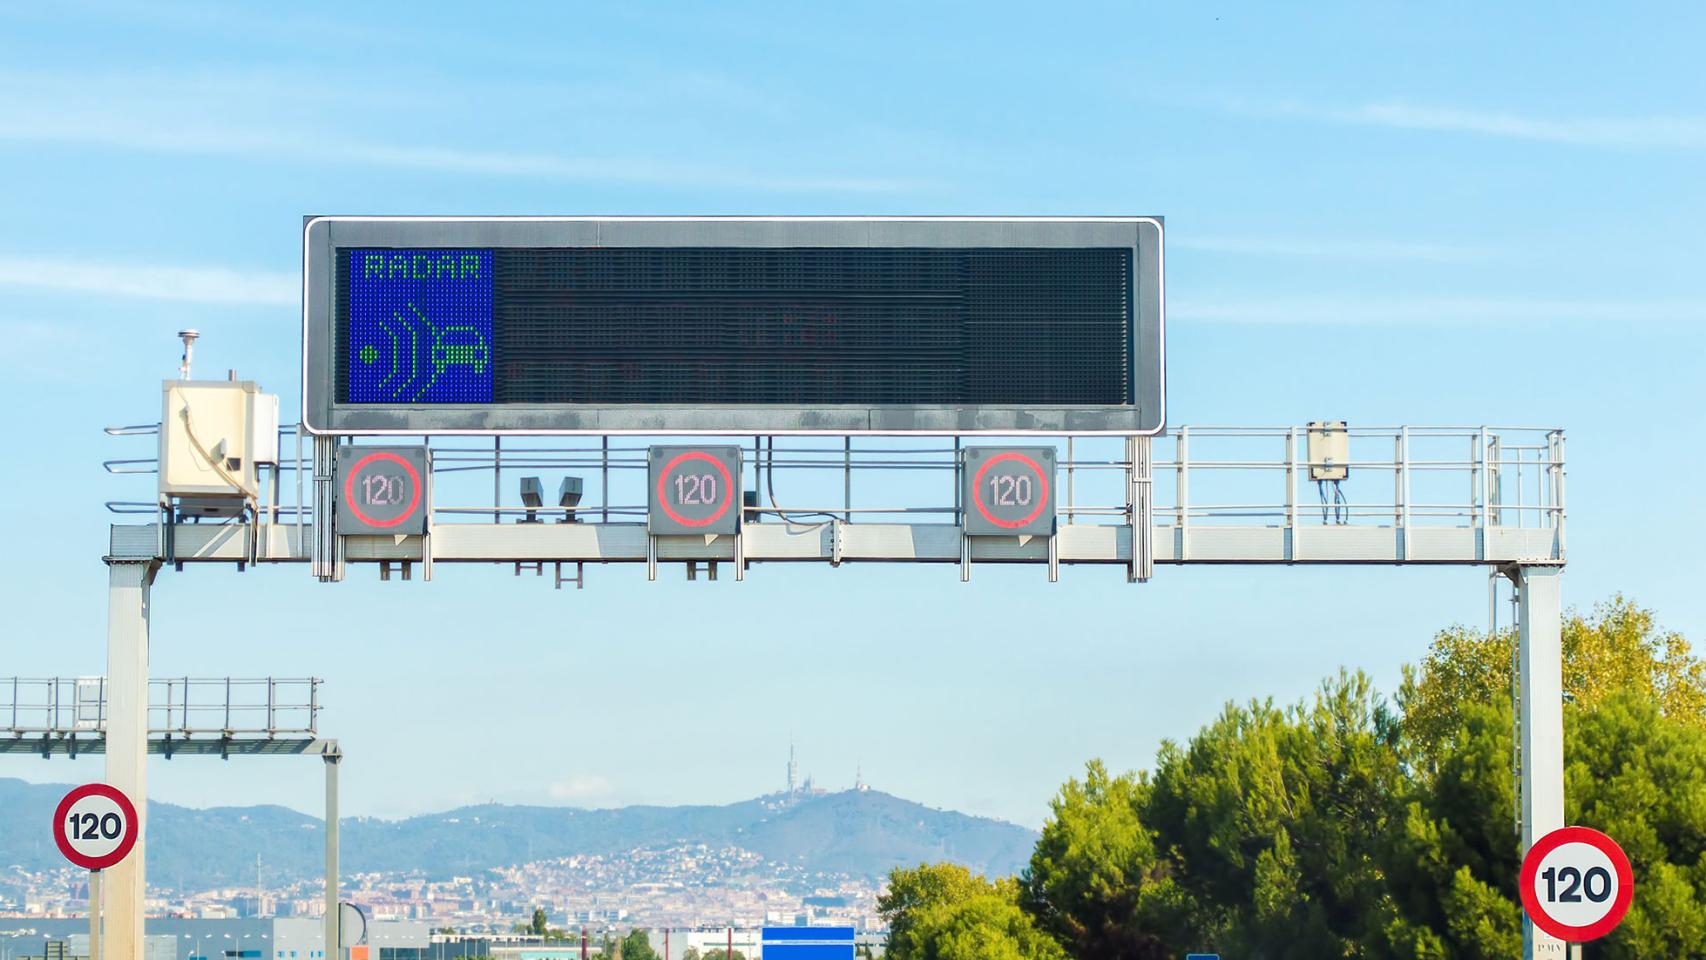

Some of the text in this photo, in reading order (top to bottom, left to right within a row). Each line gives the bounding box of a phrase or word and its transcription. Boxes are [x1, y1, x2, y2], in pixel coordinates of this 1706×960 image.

[365, 255, 479, 279] RADAR
[363, 475, 404, 504] 120
[675, 474, 716, 504] 120
[991, 475, 1031, 505] 120
[69, 812, 122, 840] 120
[1541, 866, 1612, 903] 120
